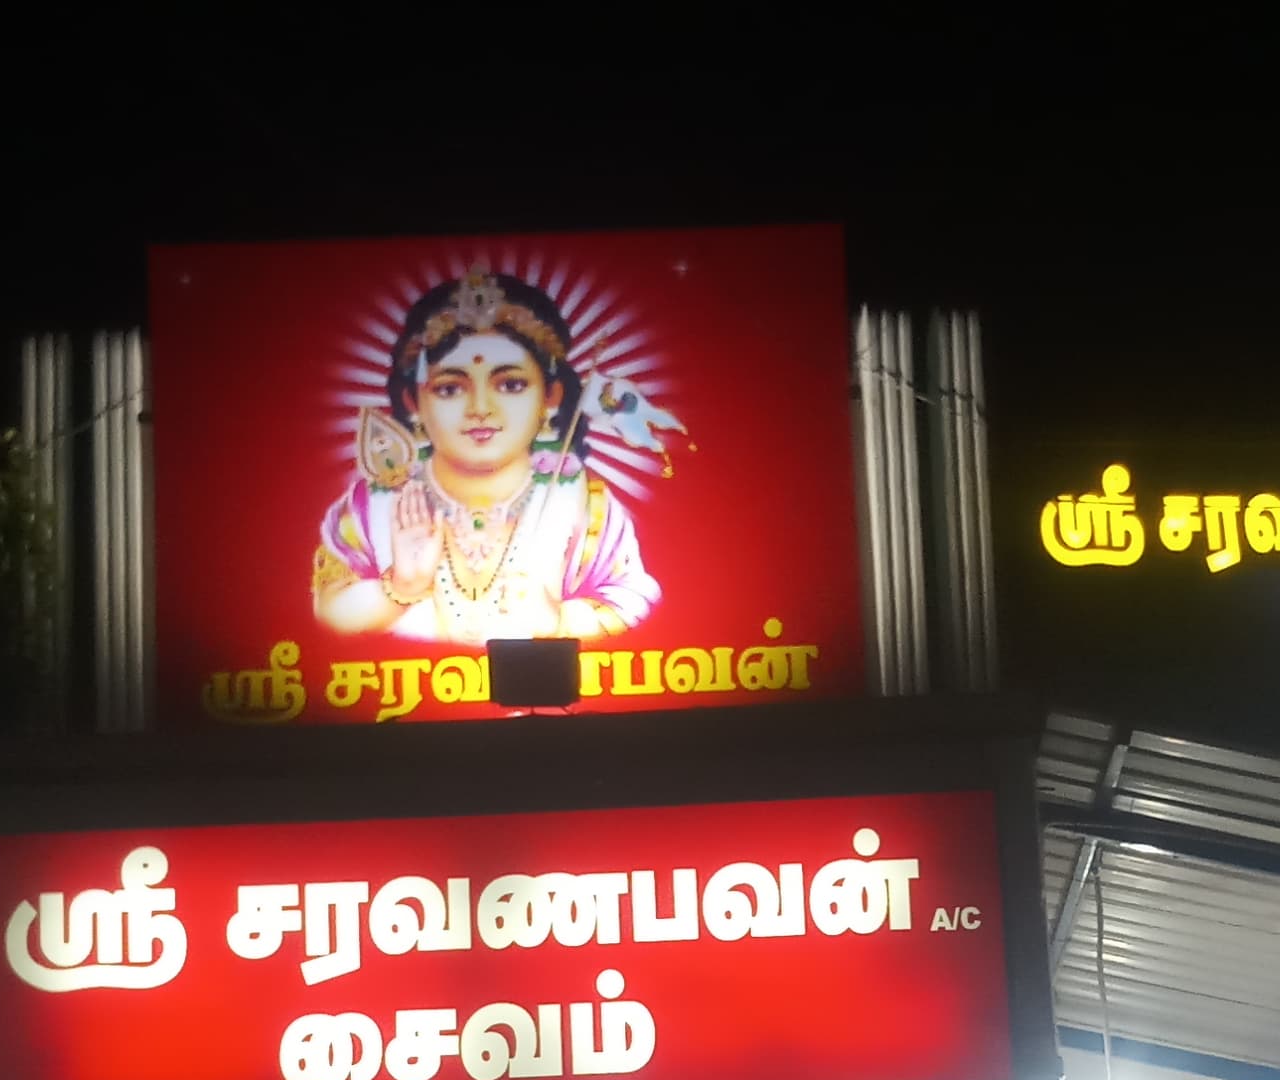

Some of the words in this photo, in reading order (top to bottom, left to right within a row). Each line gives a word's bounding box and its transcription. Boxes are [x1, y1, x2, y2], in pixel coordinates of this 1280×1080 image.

[1040, 464, 1145, 567] ஸ்ரீ
[325, 617, 818, 723] சரவபவன்
[6, 846, 188, 992] ஸ்ரீ
[226, 828, 920, 986] சரவணபவன்
[930, 906, 982, 932] A/C
